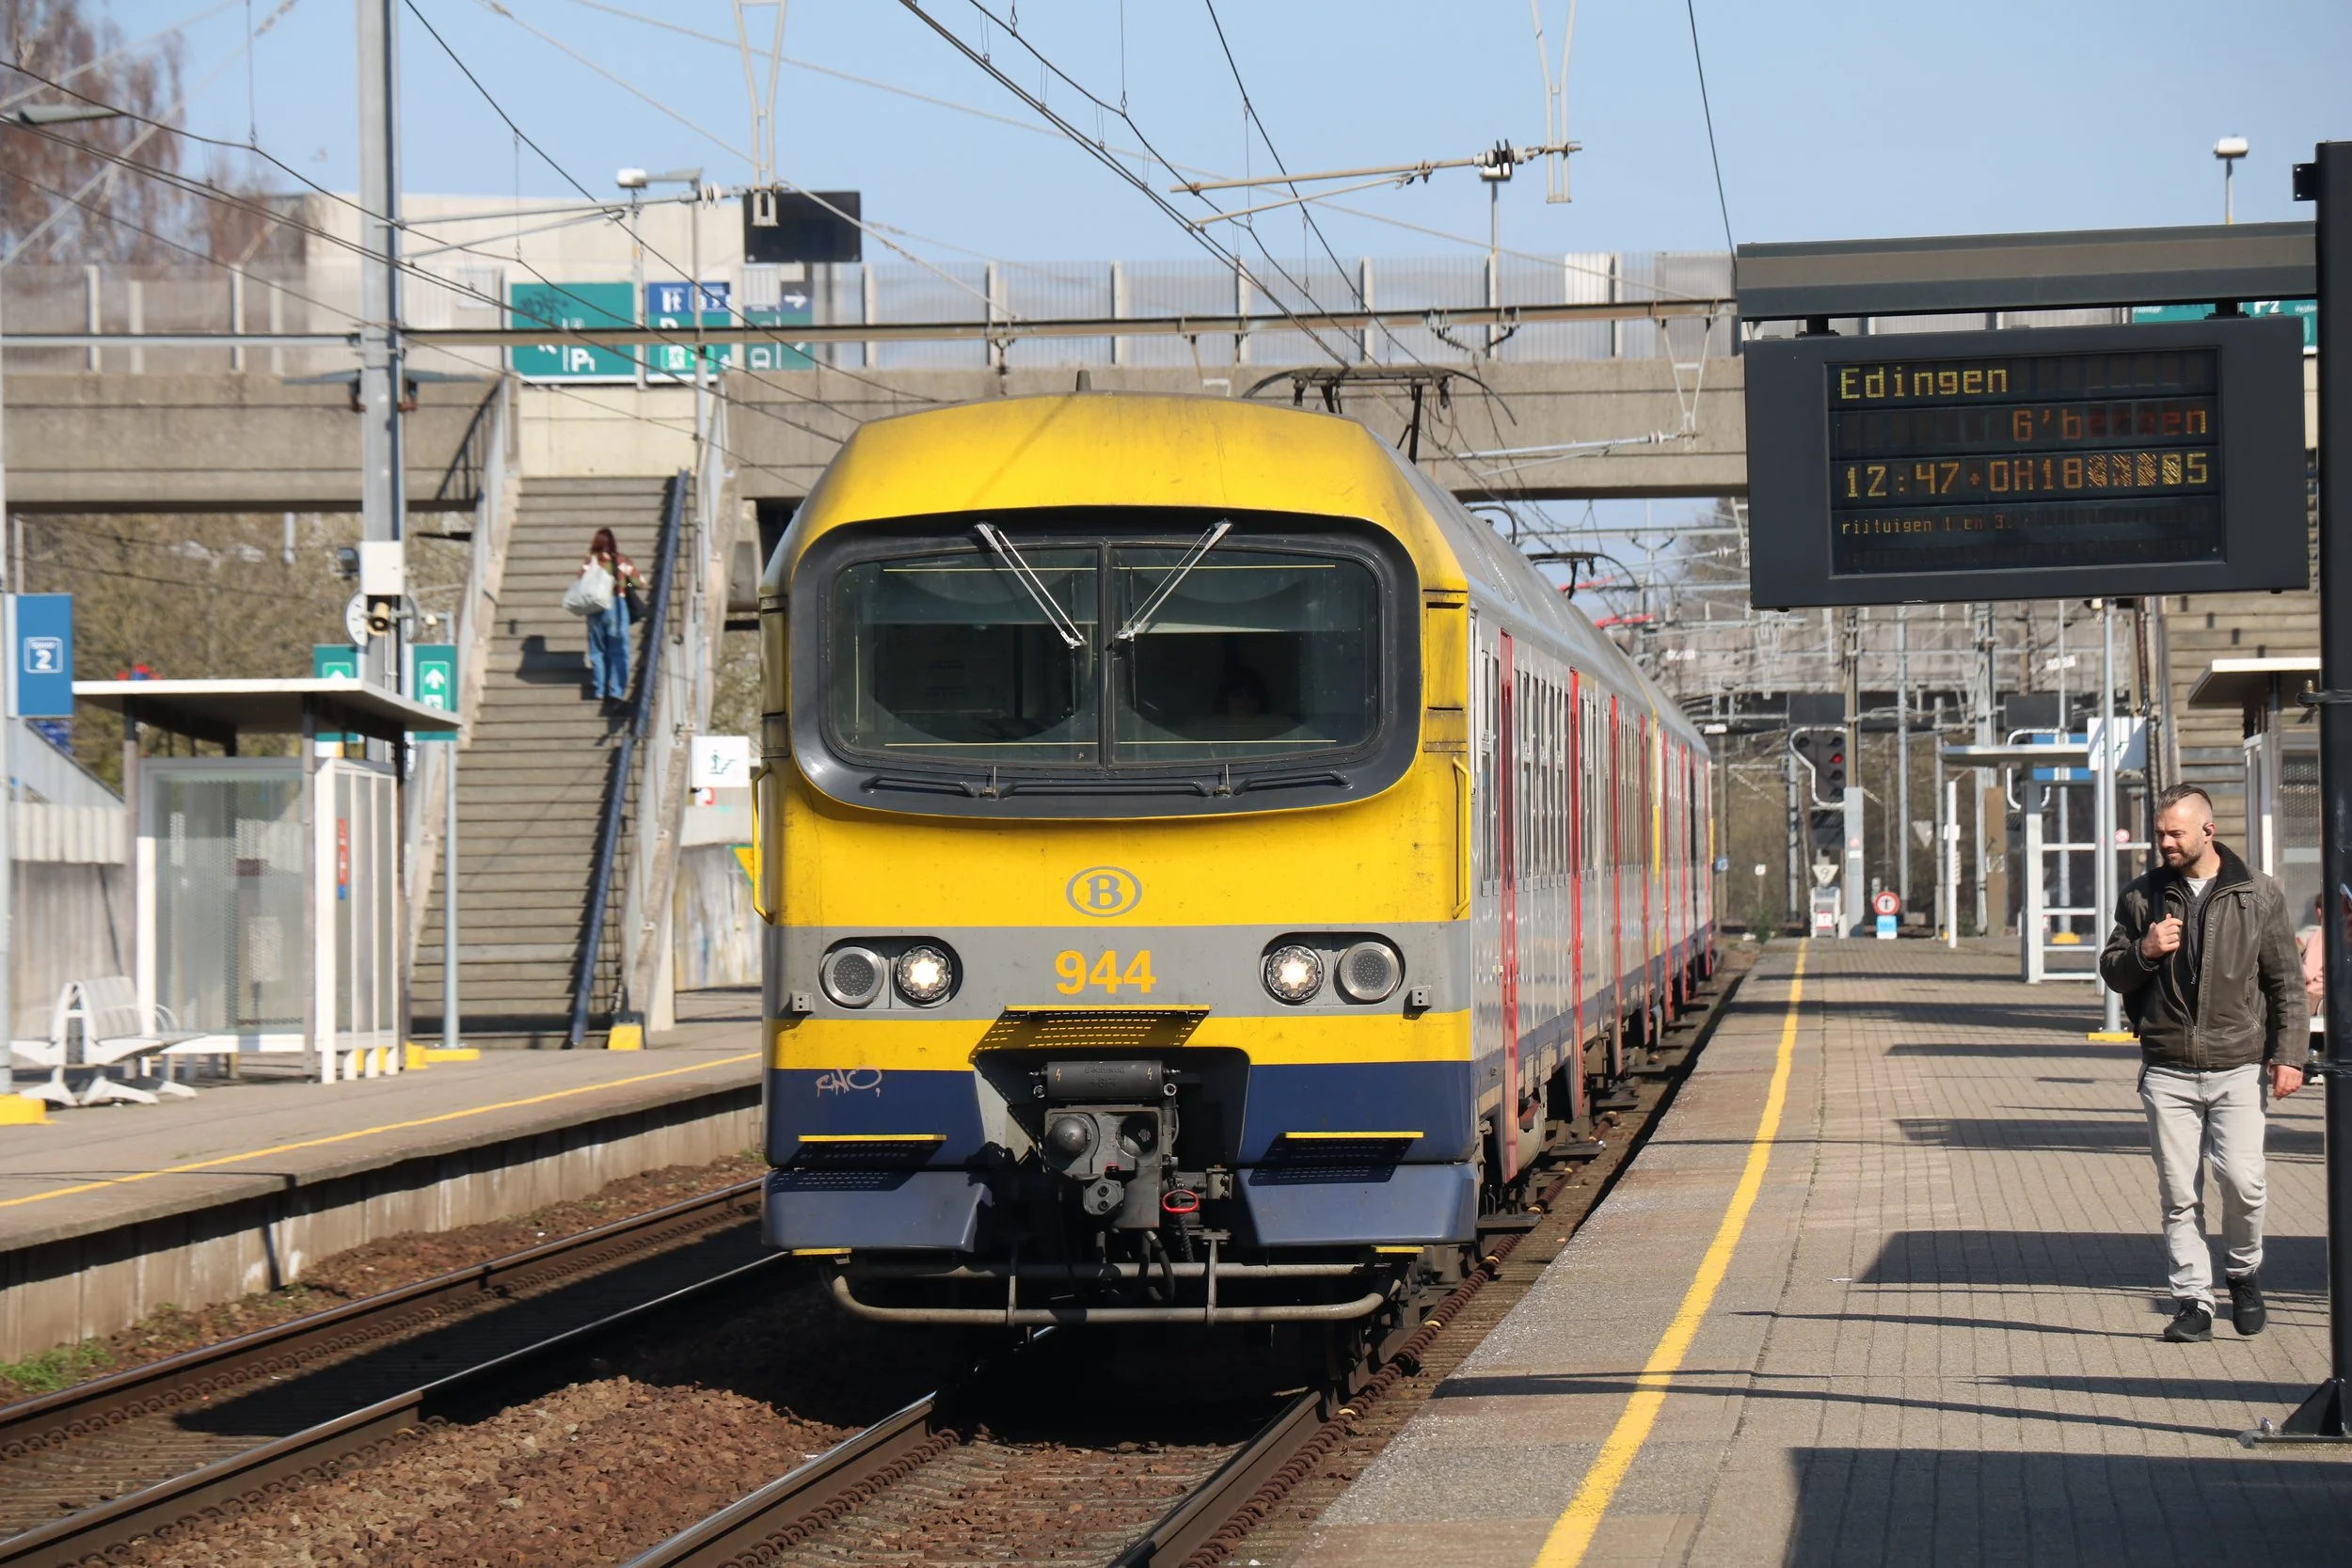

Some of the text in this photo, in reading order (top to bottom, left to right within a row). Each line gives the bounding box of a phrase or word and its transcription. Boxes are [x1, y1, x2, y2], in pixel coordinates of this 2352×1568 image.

[1840, 367, 2007, 399] Edingen
[1847, 462, 1960, 497] 12:47
[1842, 518, 1932, 534] rijtuigen
[35, 649, 53, 670] 2
[1086, 874, 1123, 910] B
[1055, 949, 1157, 996] 944
